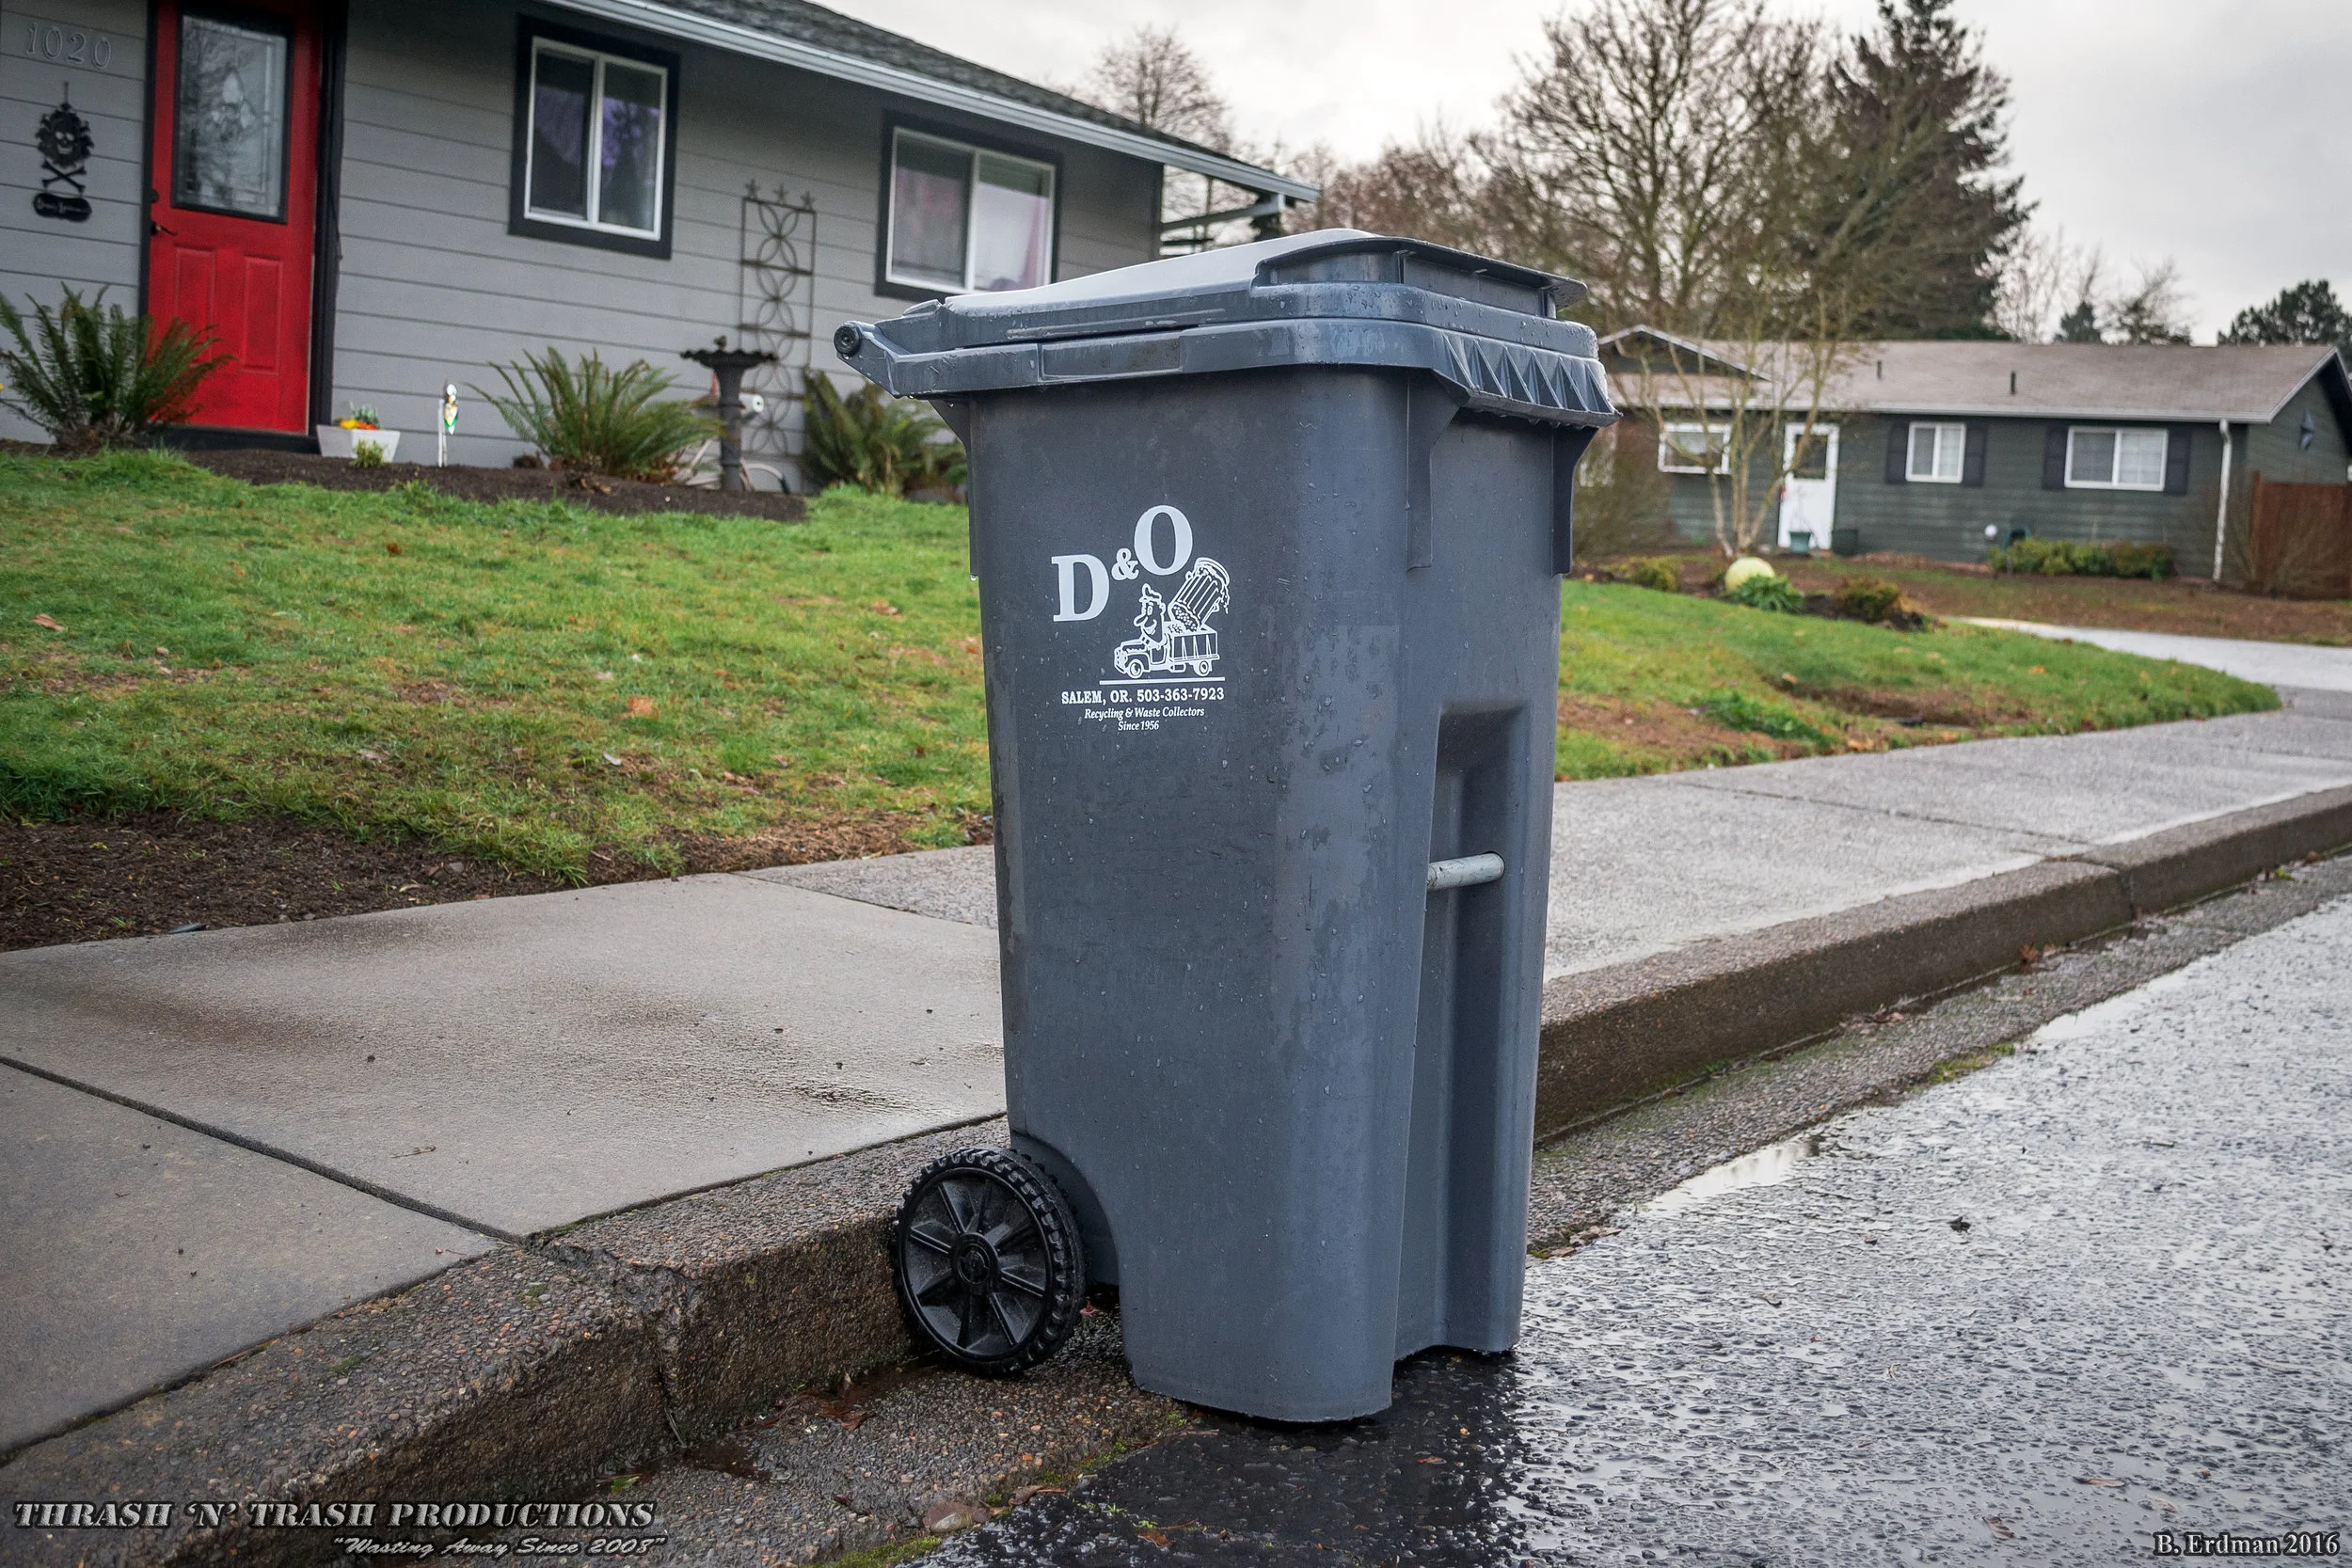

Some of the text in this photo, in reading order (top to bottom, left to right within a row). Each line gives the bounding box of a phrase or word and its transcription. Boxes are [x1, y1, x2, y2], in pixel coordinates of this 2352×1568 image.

[25, 22, 112, 69] 1020
[1061, 688, 1224, 705] SALEM, OR. 503-363-7923
[1084, 706, 1205, 721] Recycling & Waste Collectors
[1118, 721, 1160, 731] Since 1956
